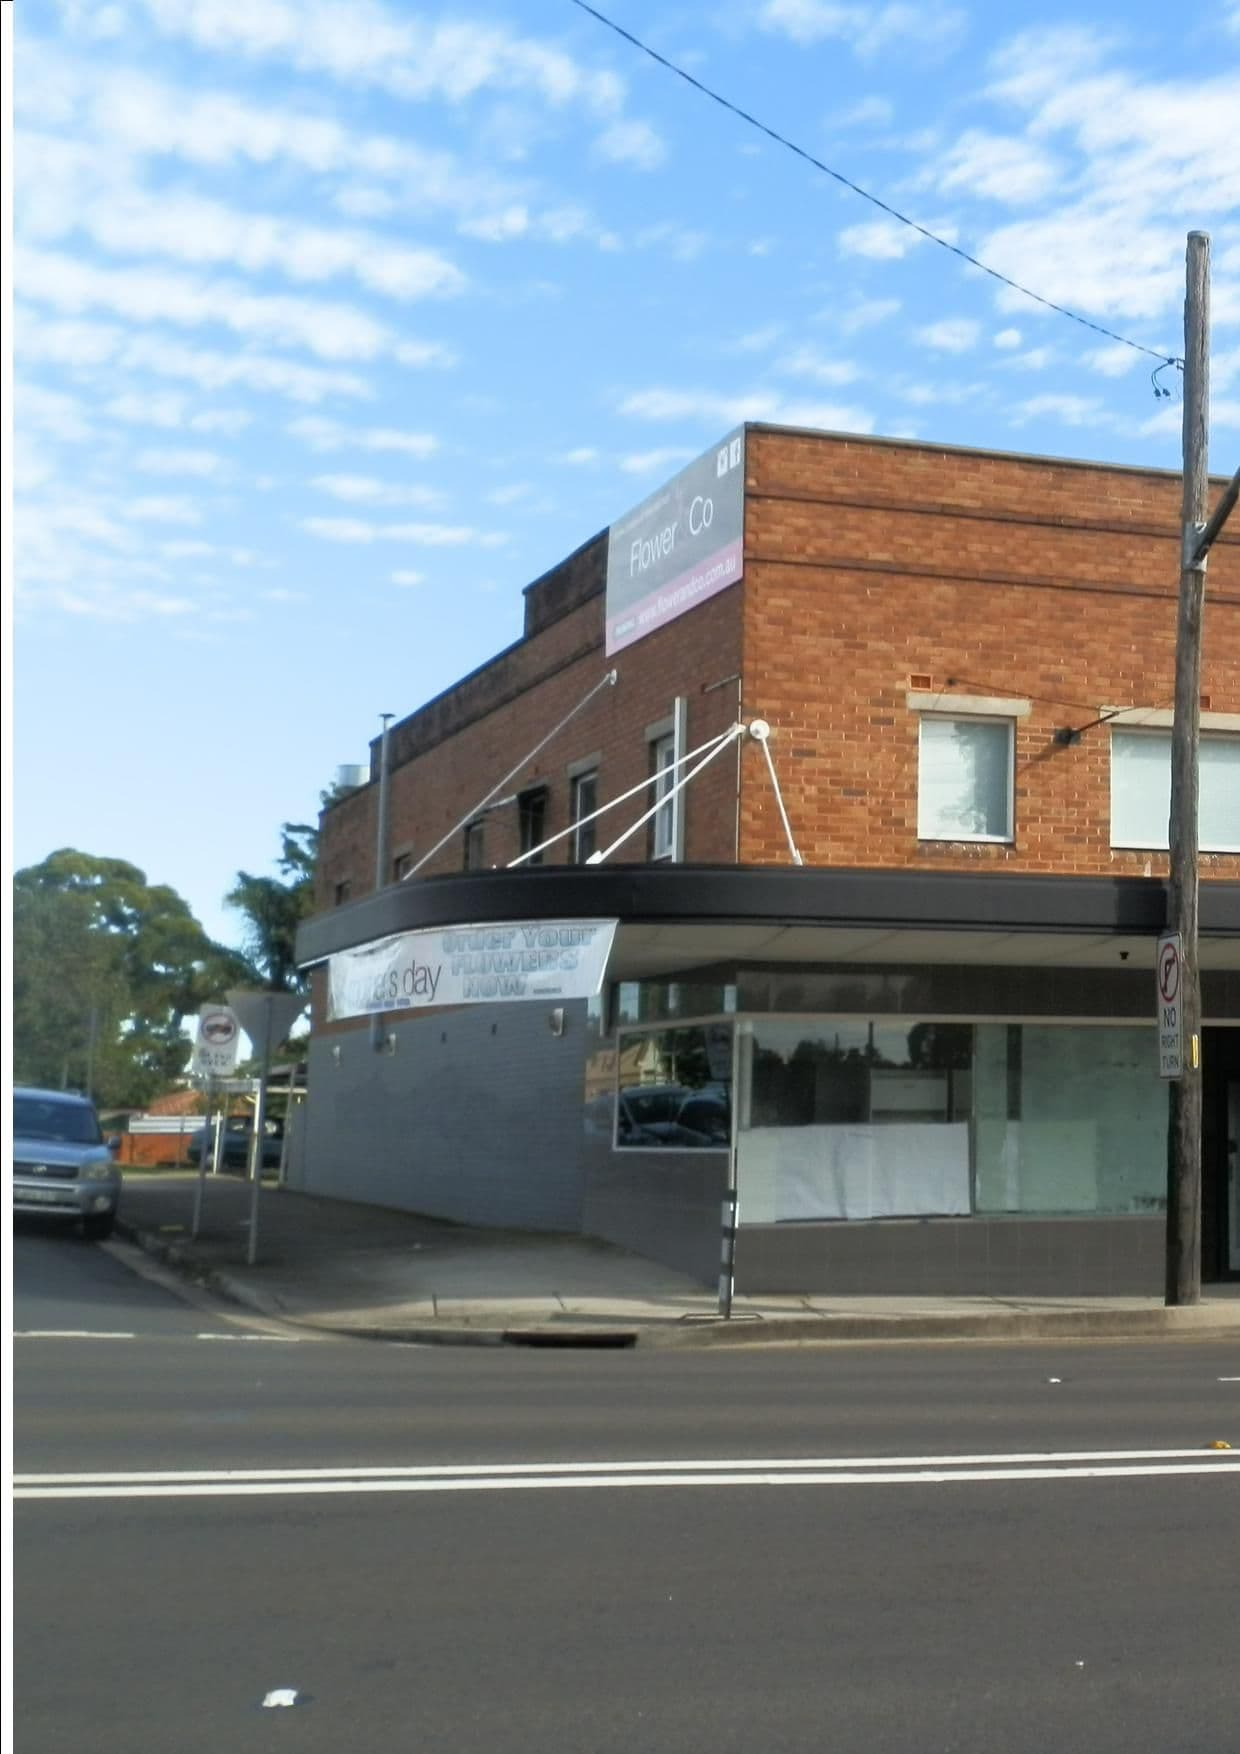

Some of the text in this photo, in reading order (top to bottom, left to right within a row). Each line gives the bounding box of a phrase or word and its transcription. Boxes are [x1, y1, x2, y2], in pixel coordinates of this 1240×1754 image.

[403, 959, 442, 1002] day
[1163, 1007, 1177, 1028] NO
[1161, 1033, 1179, 1049] RIGHT
[1162, 1054, 1180, 1069] TURN
